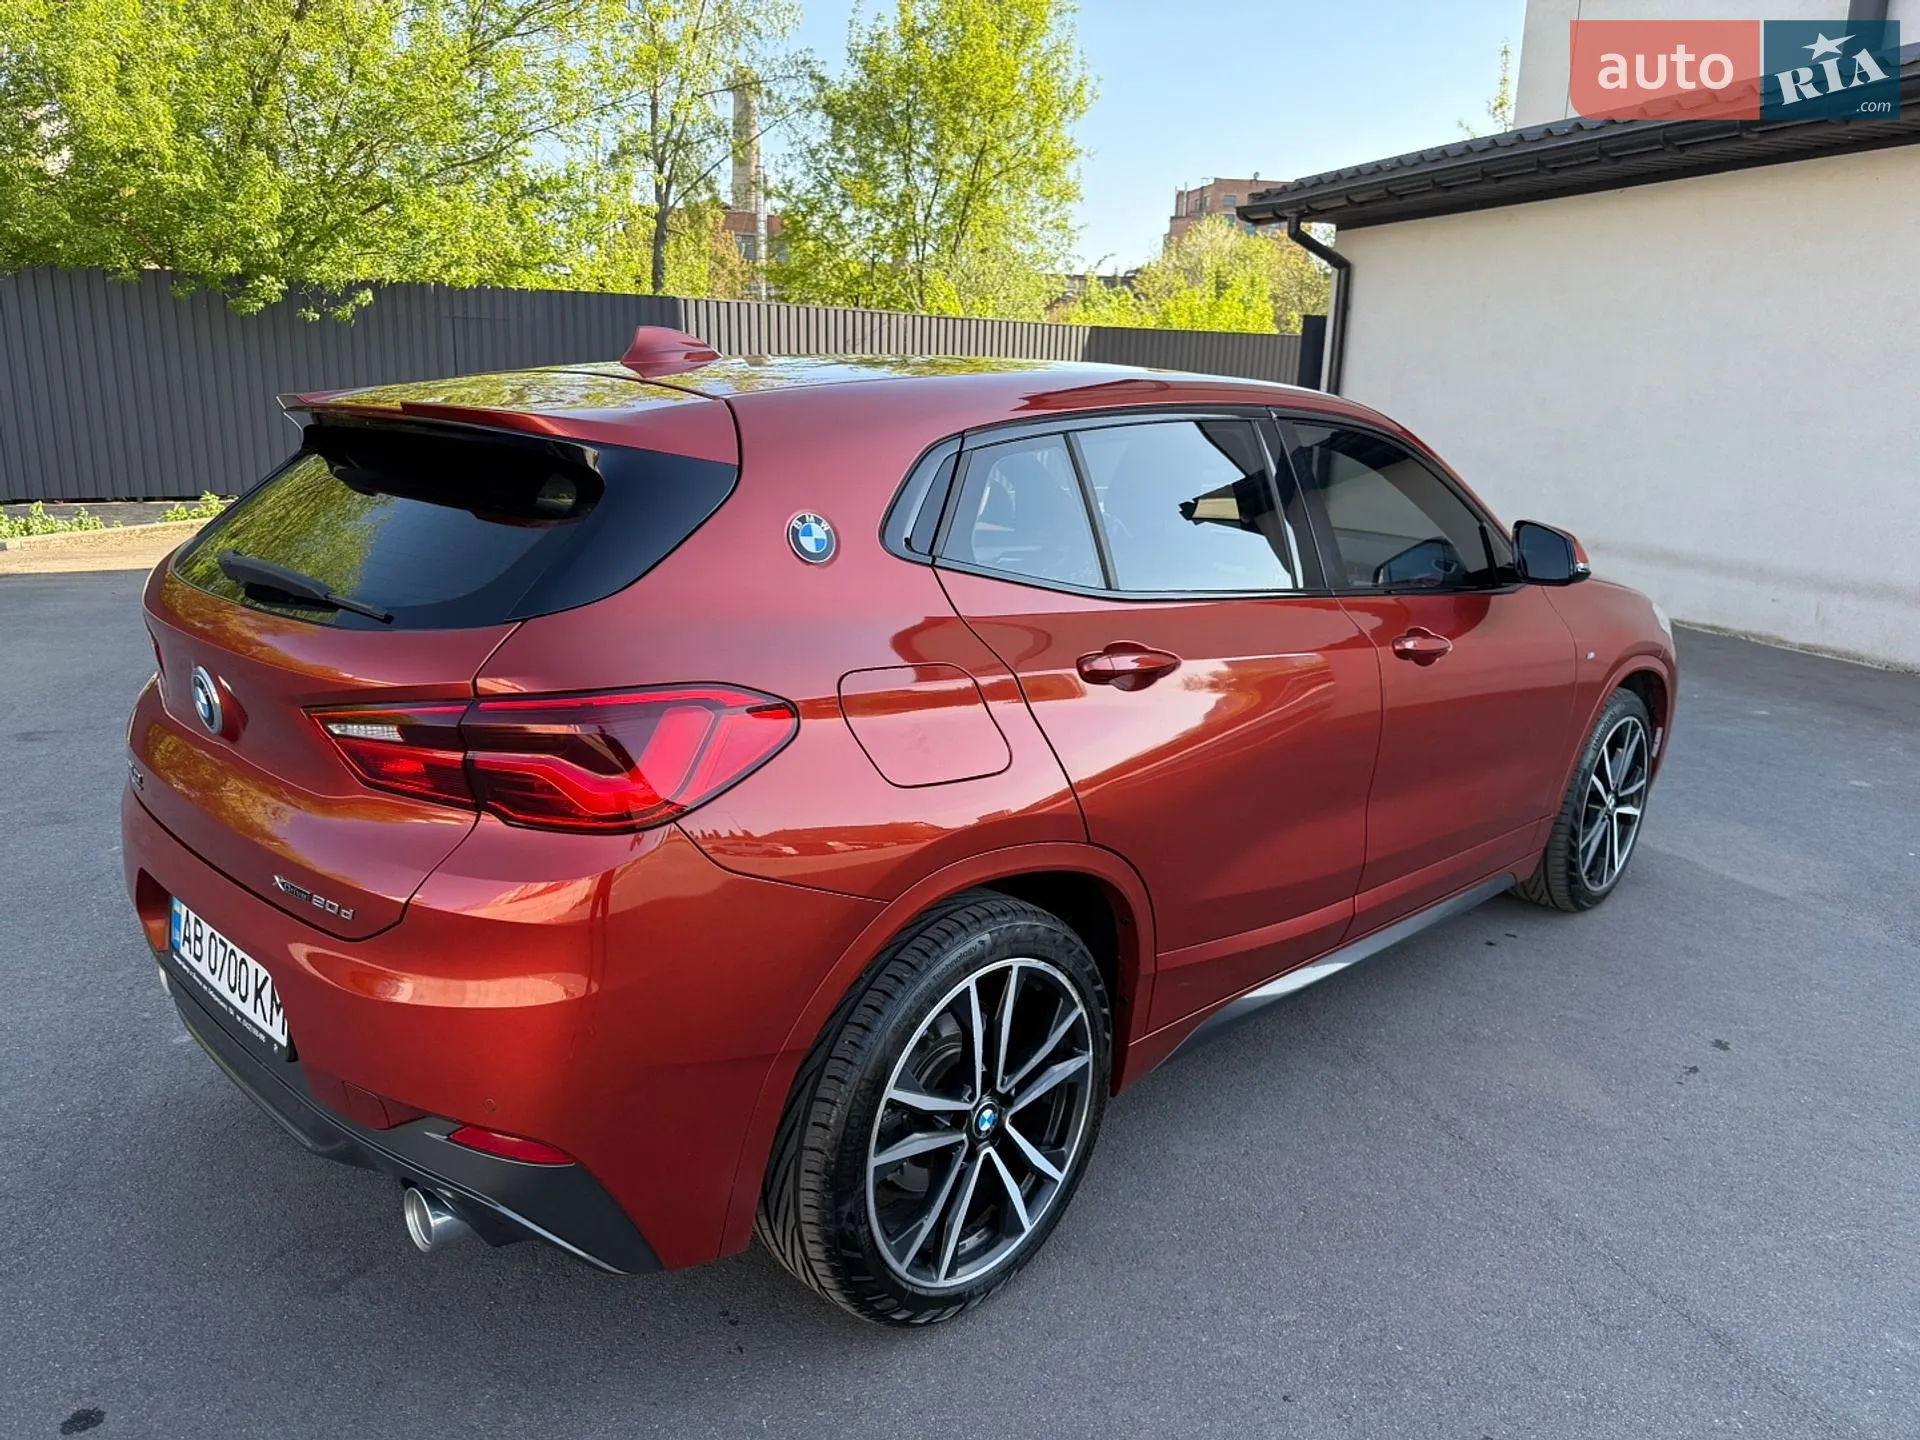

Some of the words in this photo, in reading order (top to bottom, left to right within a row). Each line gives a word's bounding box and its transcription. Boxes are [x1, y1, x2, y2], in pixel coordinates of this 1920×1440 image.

[182, 909, 204, 963] AB
[208, 932, 250, 1004] 0700
[253, 968, 287, 1036] KM
